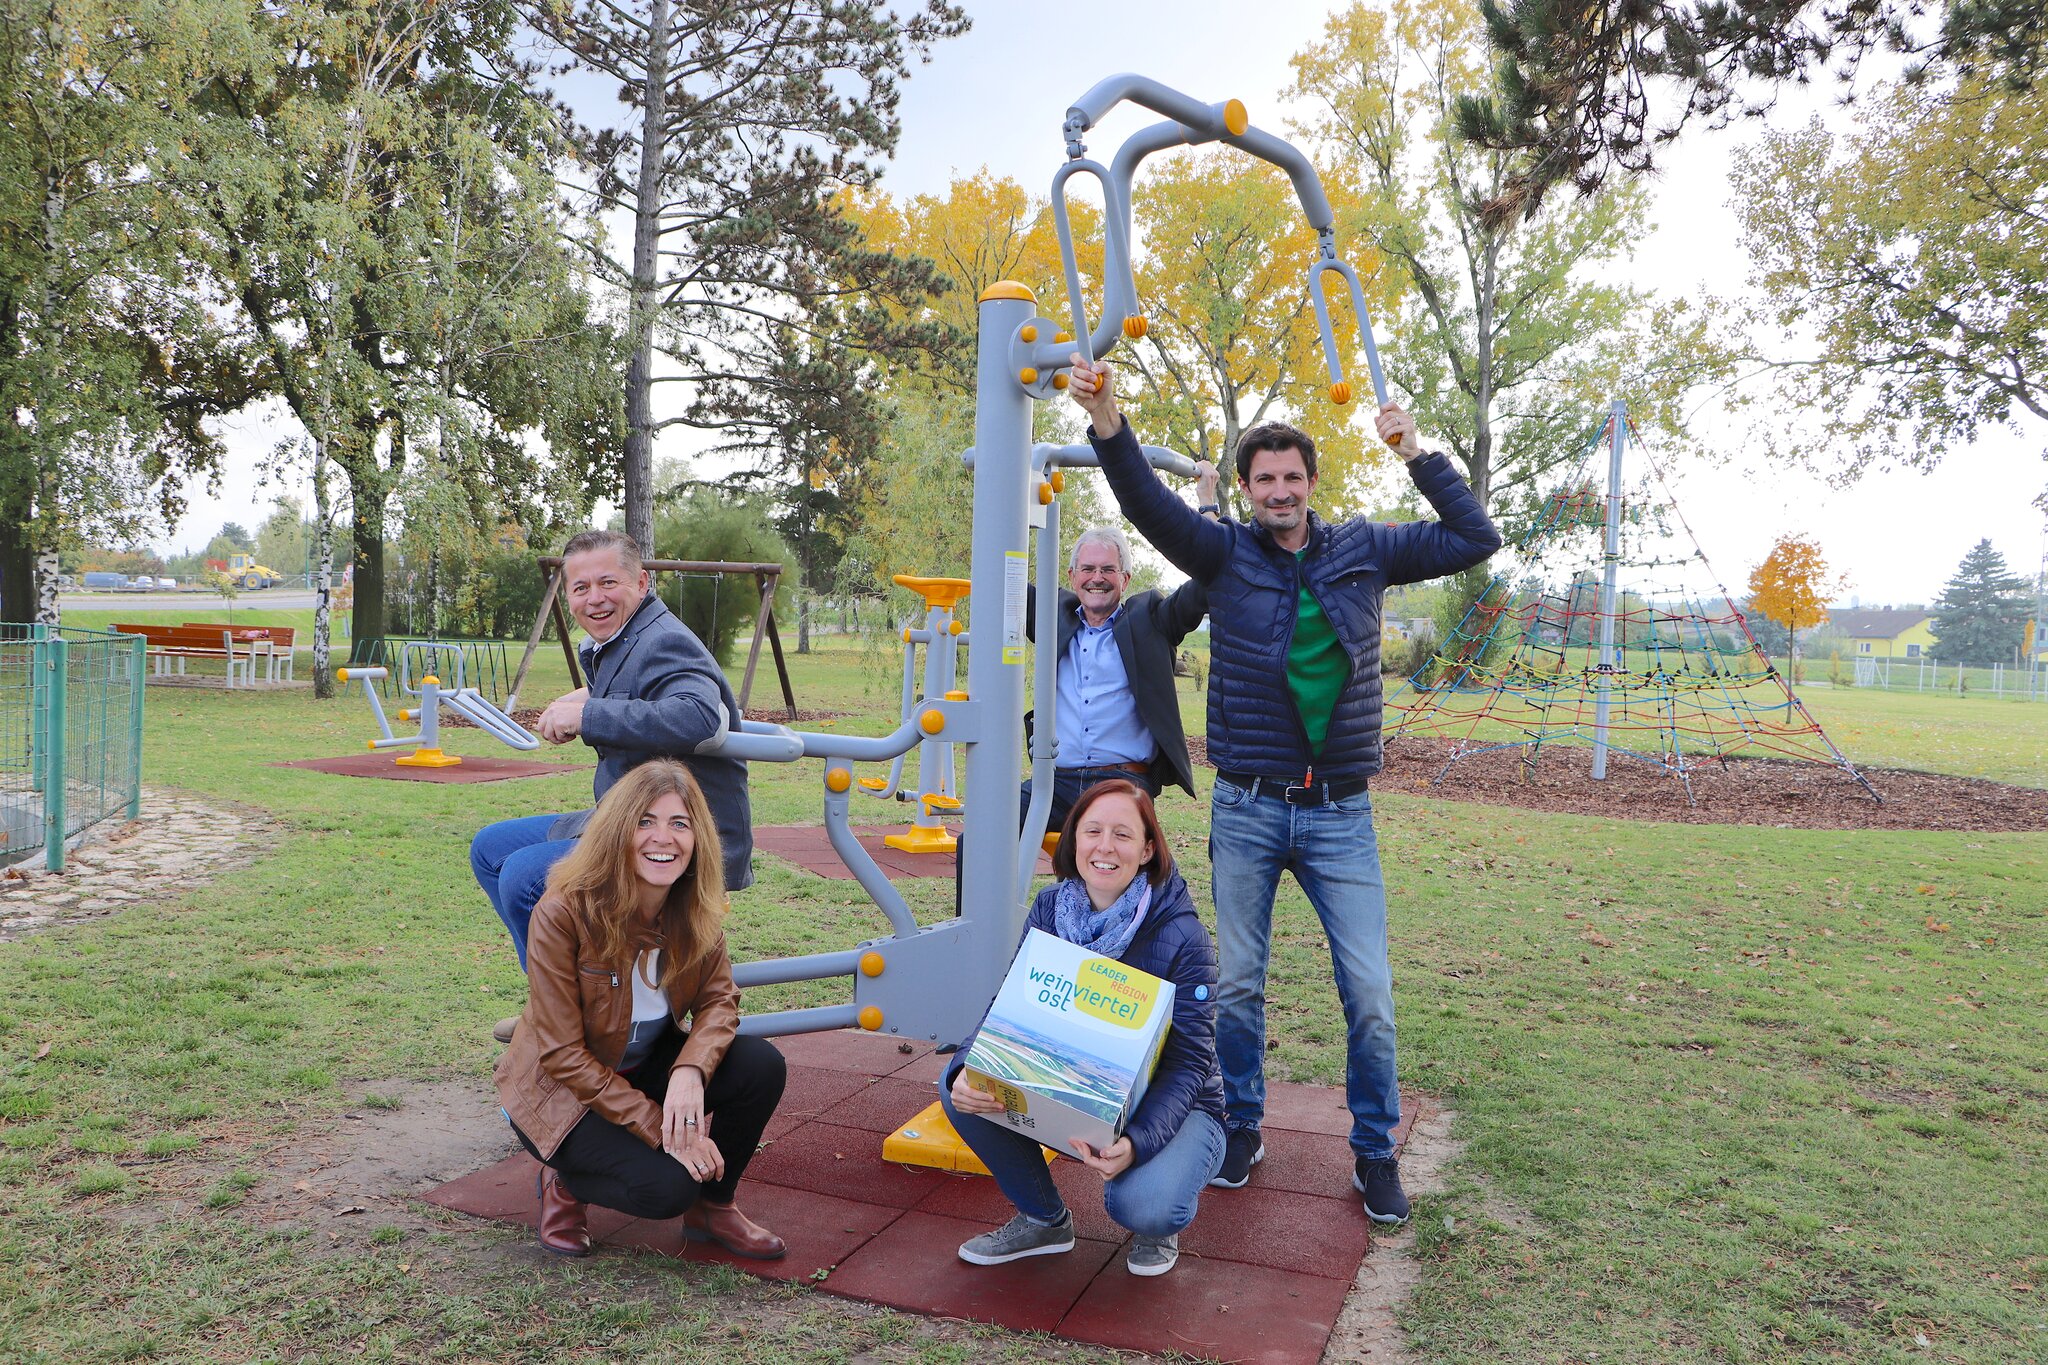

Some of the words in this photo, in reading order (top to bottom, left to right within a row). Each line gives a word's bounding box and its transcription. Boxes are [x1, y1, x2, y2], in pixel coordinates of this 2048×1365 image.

[1090, 962, 1128, 983] LEADER
[1038, 988, 1071, 1012] ost
[1110, 981, 1149, 1003] REGION
